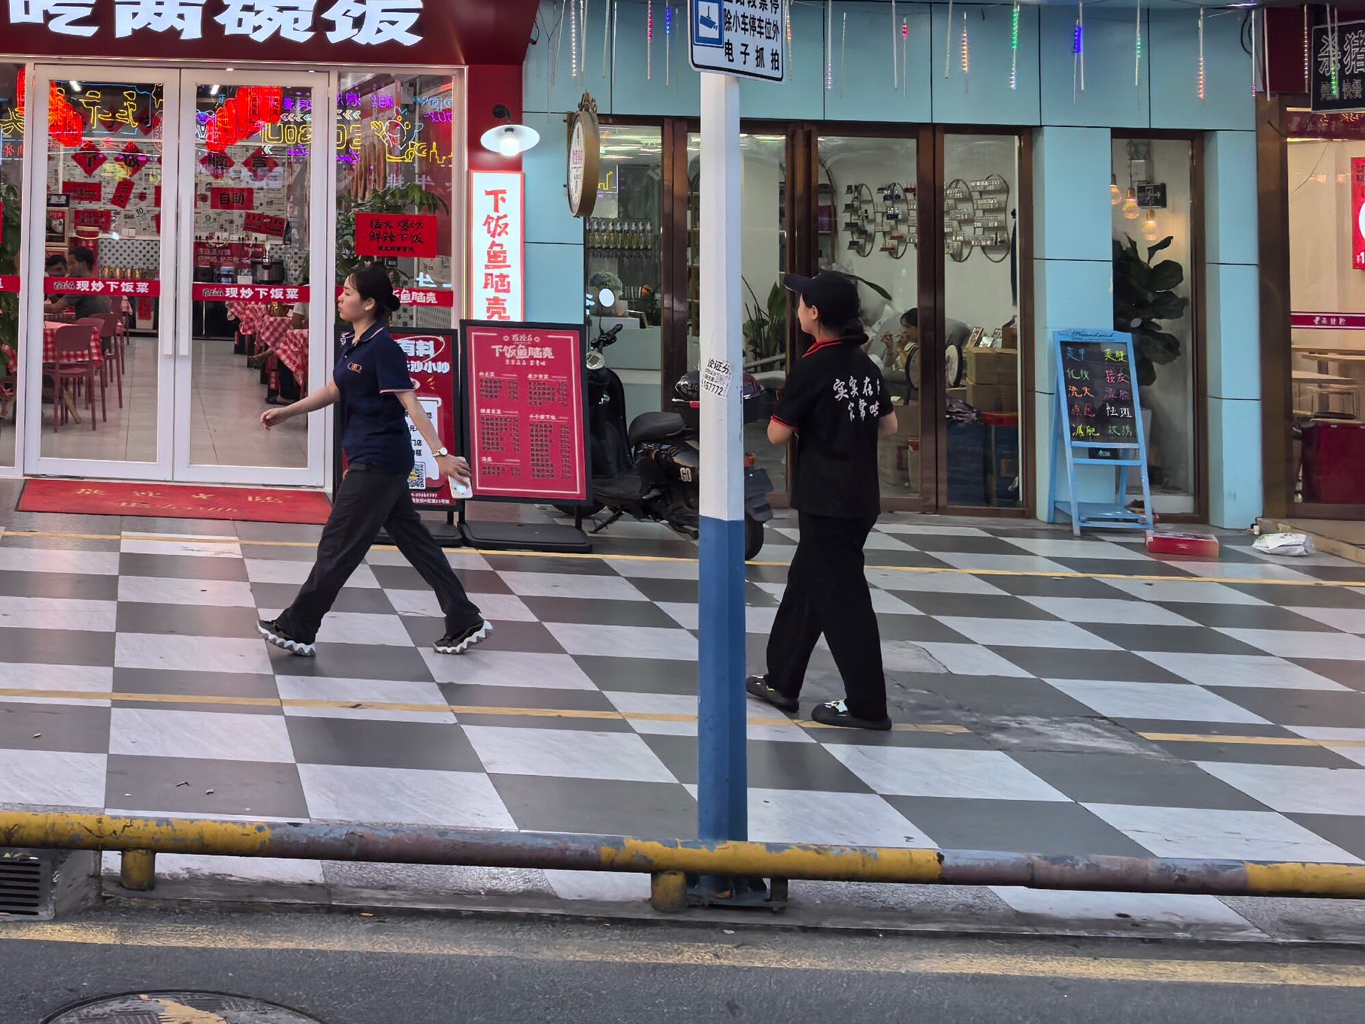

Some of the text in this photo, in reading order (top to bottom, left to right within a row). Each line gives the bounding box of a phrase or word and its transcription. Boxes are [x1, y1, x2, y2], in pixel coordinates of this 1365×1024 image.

[724, 39, 780, 72] 电子抓拍
[76, 280, 150, 294] 现炒下饭菜
[224, 287, 299, 300] 现炒下饭菜
[833, 375, 881, 402] 实实在
